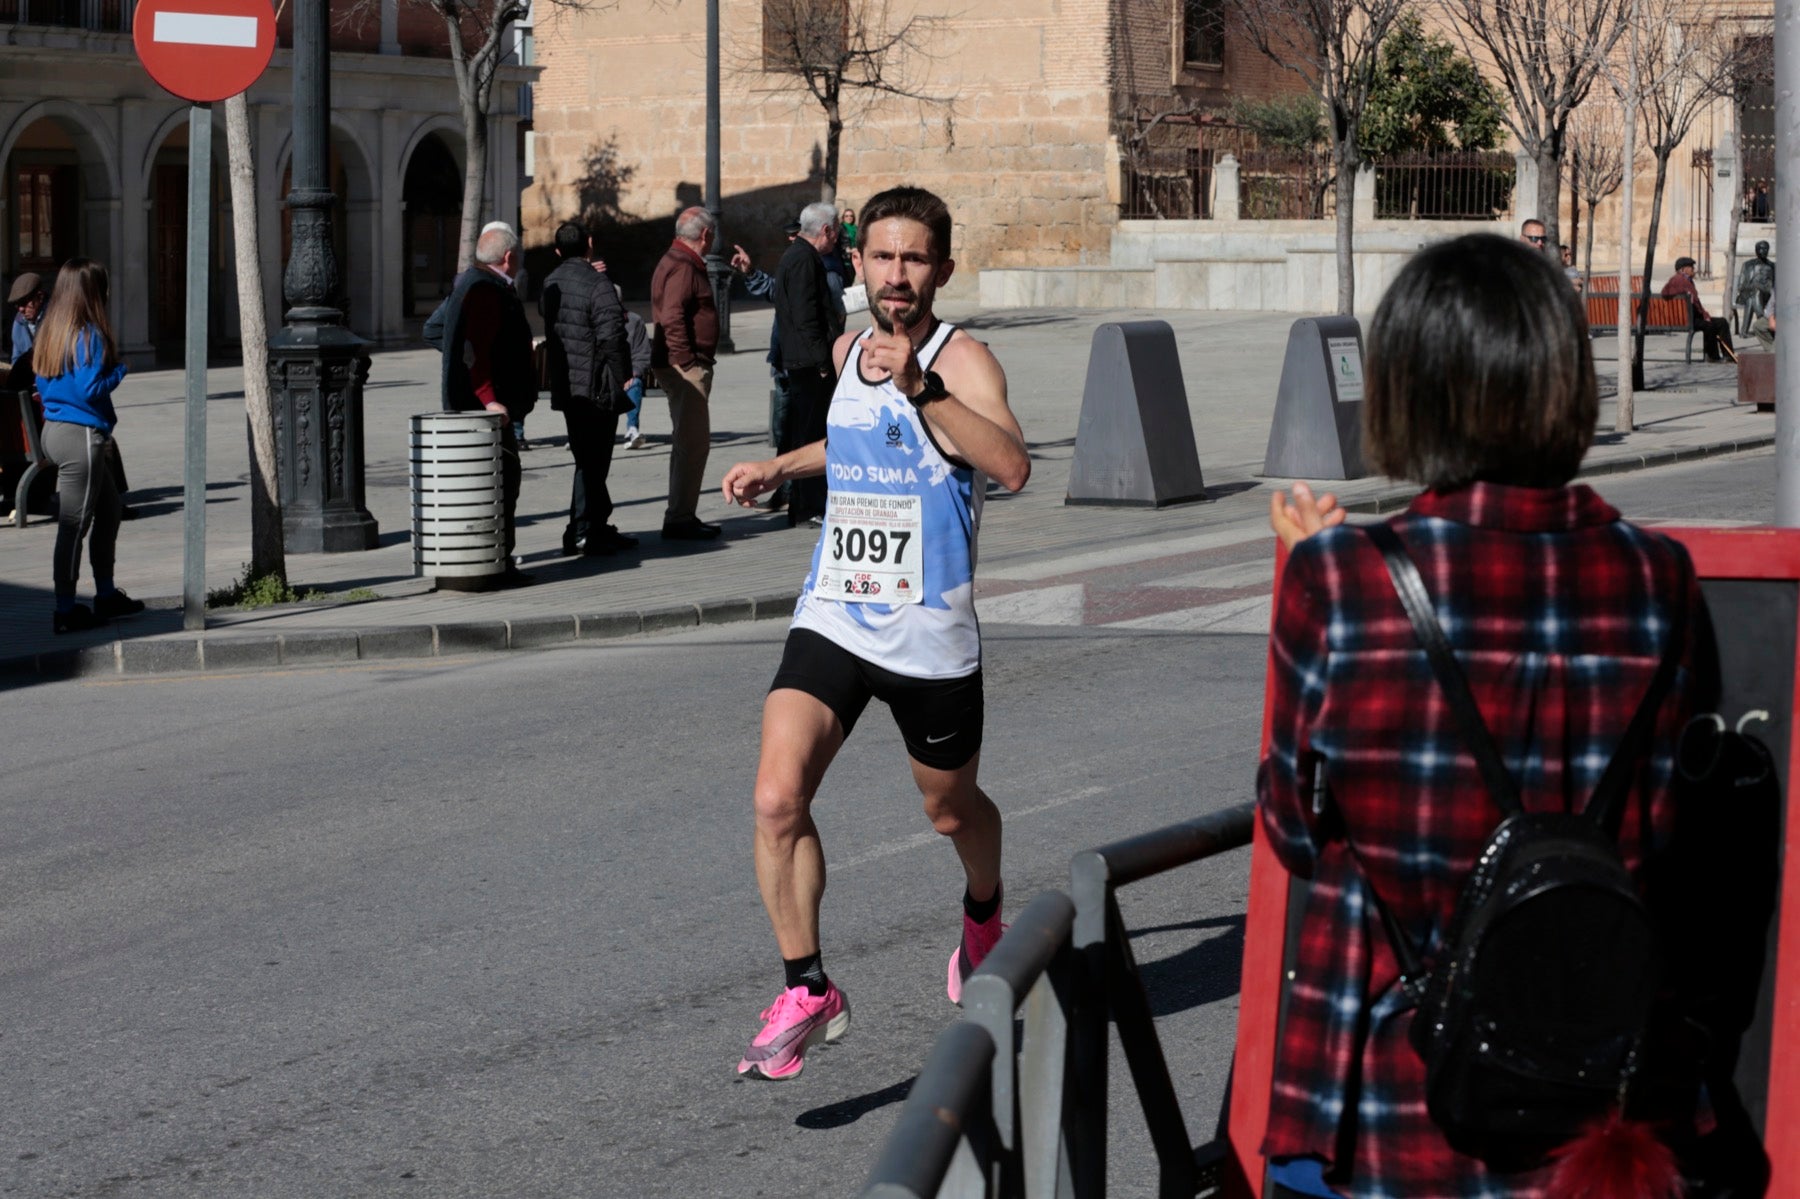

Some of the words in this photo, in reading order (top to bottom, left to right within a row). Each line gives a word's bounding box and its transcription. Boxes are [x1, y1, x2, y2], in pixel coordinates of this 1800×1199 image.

[831, 464, 863, 481] TODO
[867, 466, 918, 484] SUMA
[839, 496, 855, 506] GRAN
[856, 498, 878, 508] PREMIO
[880, 499, 887, 508] DE
[832, 526, 911, 564] 3097
